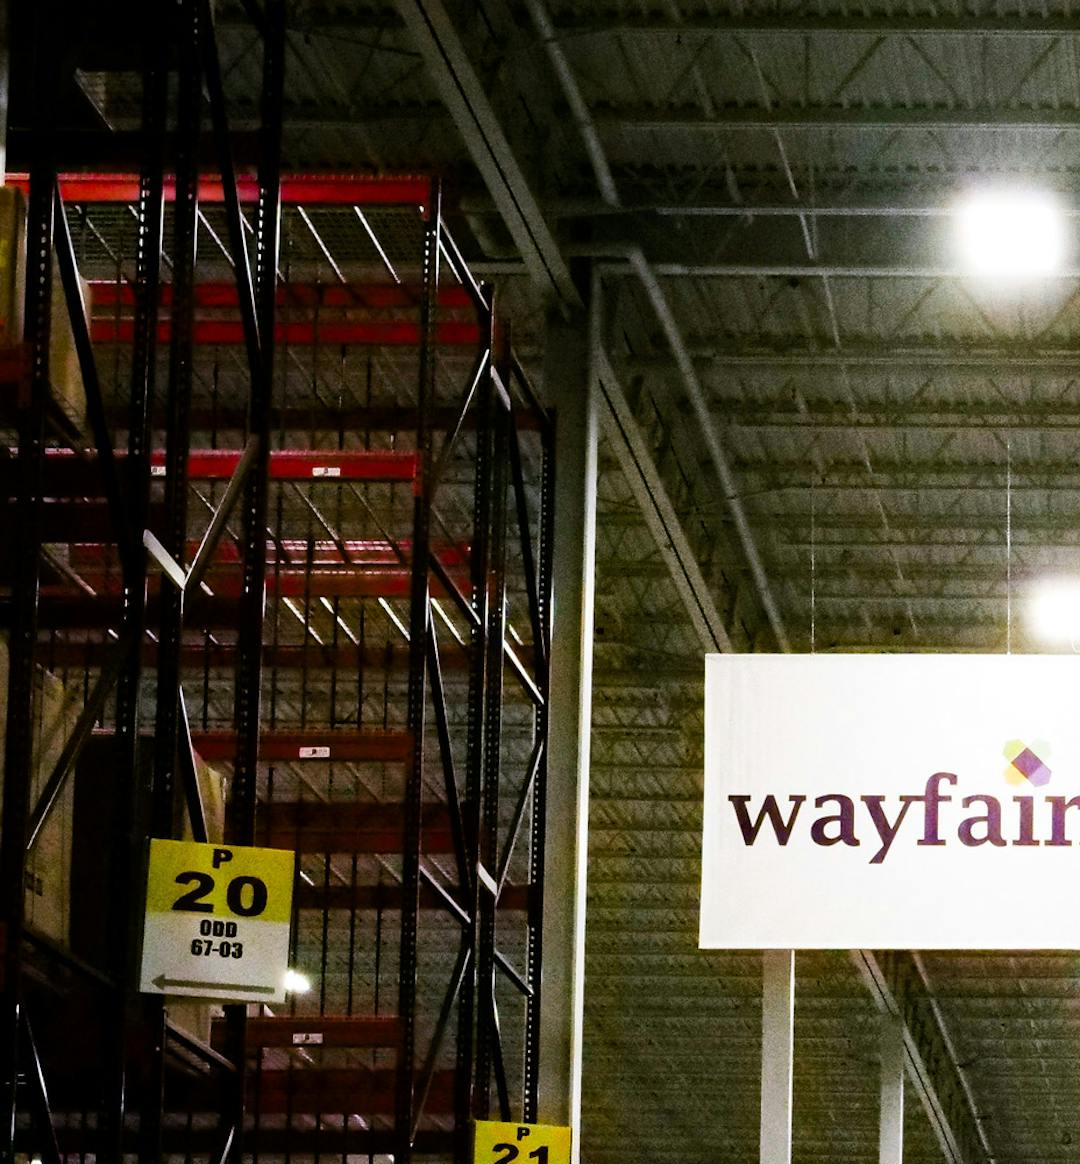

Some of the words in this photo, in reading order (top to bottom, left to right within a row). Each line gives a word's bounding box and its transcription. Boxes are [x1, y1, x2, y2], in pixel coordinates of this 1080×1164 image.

[212, 849, 233, 869] P
[171, 872, 268, 917] 20
[200, 920, 238, 938] ODD
[191, 939, 243, 959] 67-03
[517, 1127, 530, 1141] P
